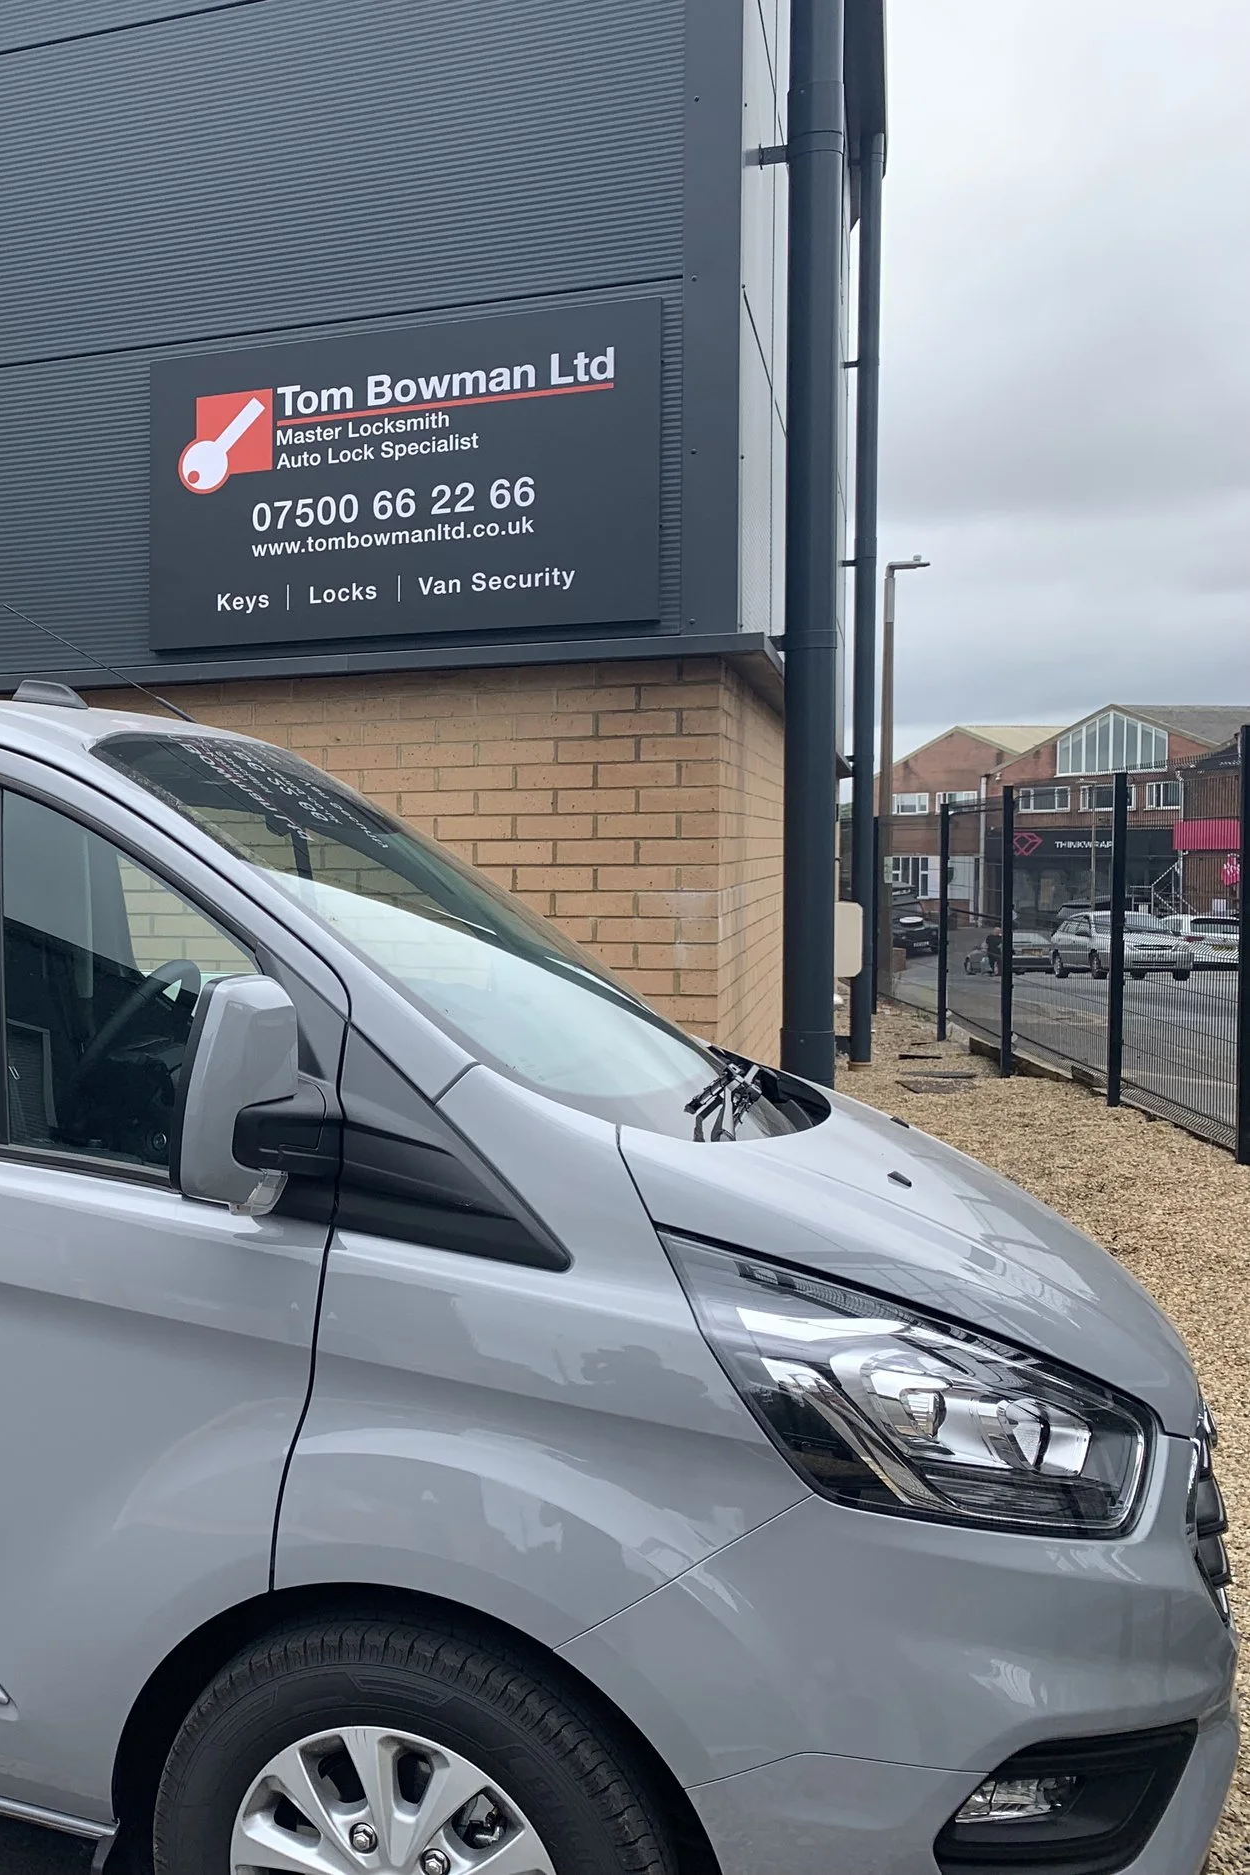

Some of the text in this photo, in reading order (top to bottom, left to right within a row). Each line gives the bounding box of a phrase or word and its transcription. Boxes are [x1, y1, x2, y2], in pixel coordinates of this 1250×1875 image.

[276, 346, 615, 417] Tom Bowman Ltd
[276, 411, 450, 446] Master Locksmith
[276, 432, 479, 470] Auto Lock Specialist
[252, 476, 536, 532] 07500 66 22 66
[251, 515, 535, 558] www.tombowmanltd.co.uk
[309, 582, 378, 604] Locks
[418, 567, 576, 596] Van Security
[216, 592, 270, 614] Keys
